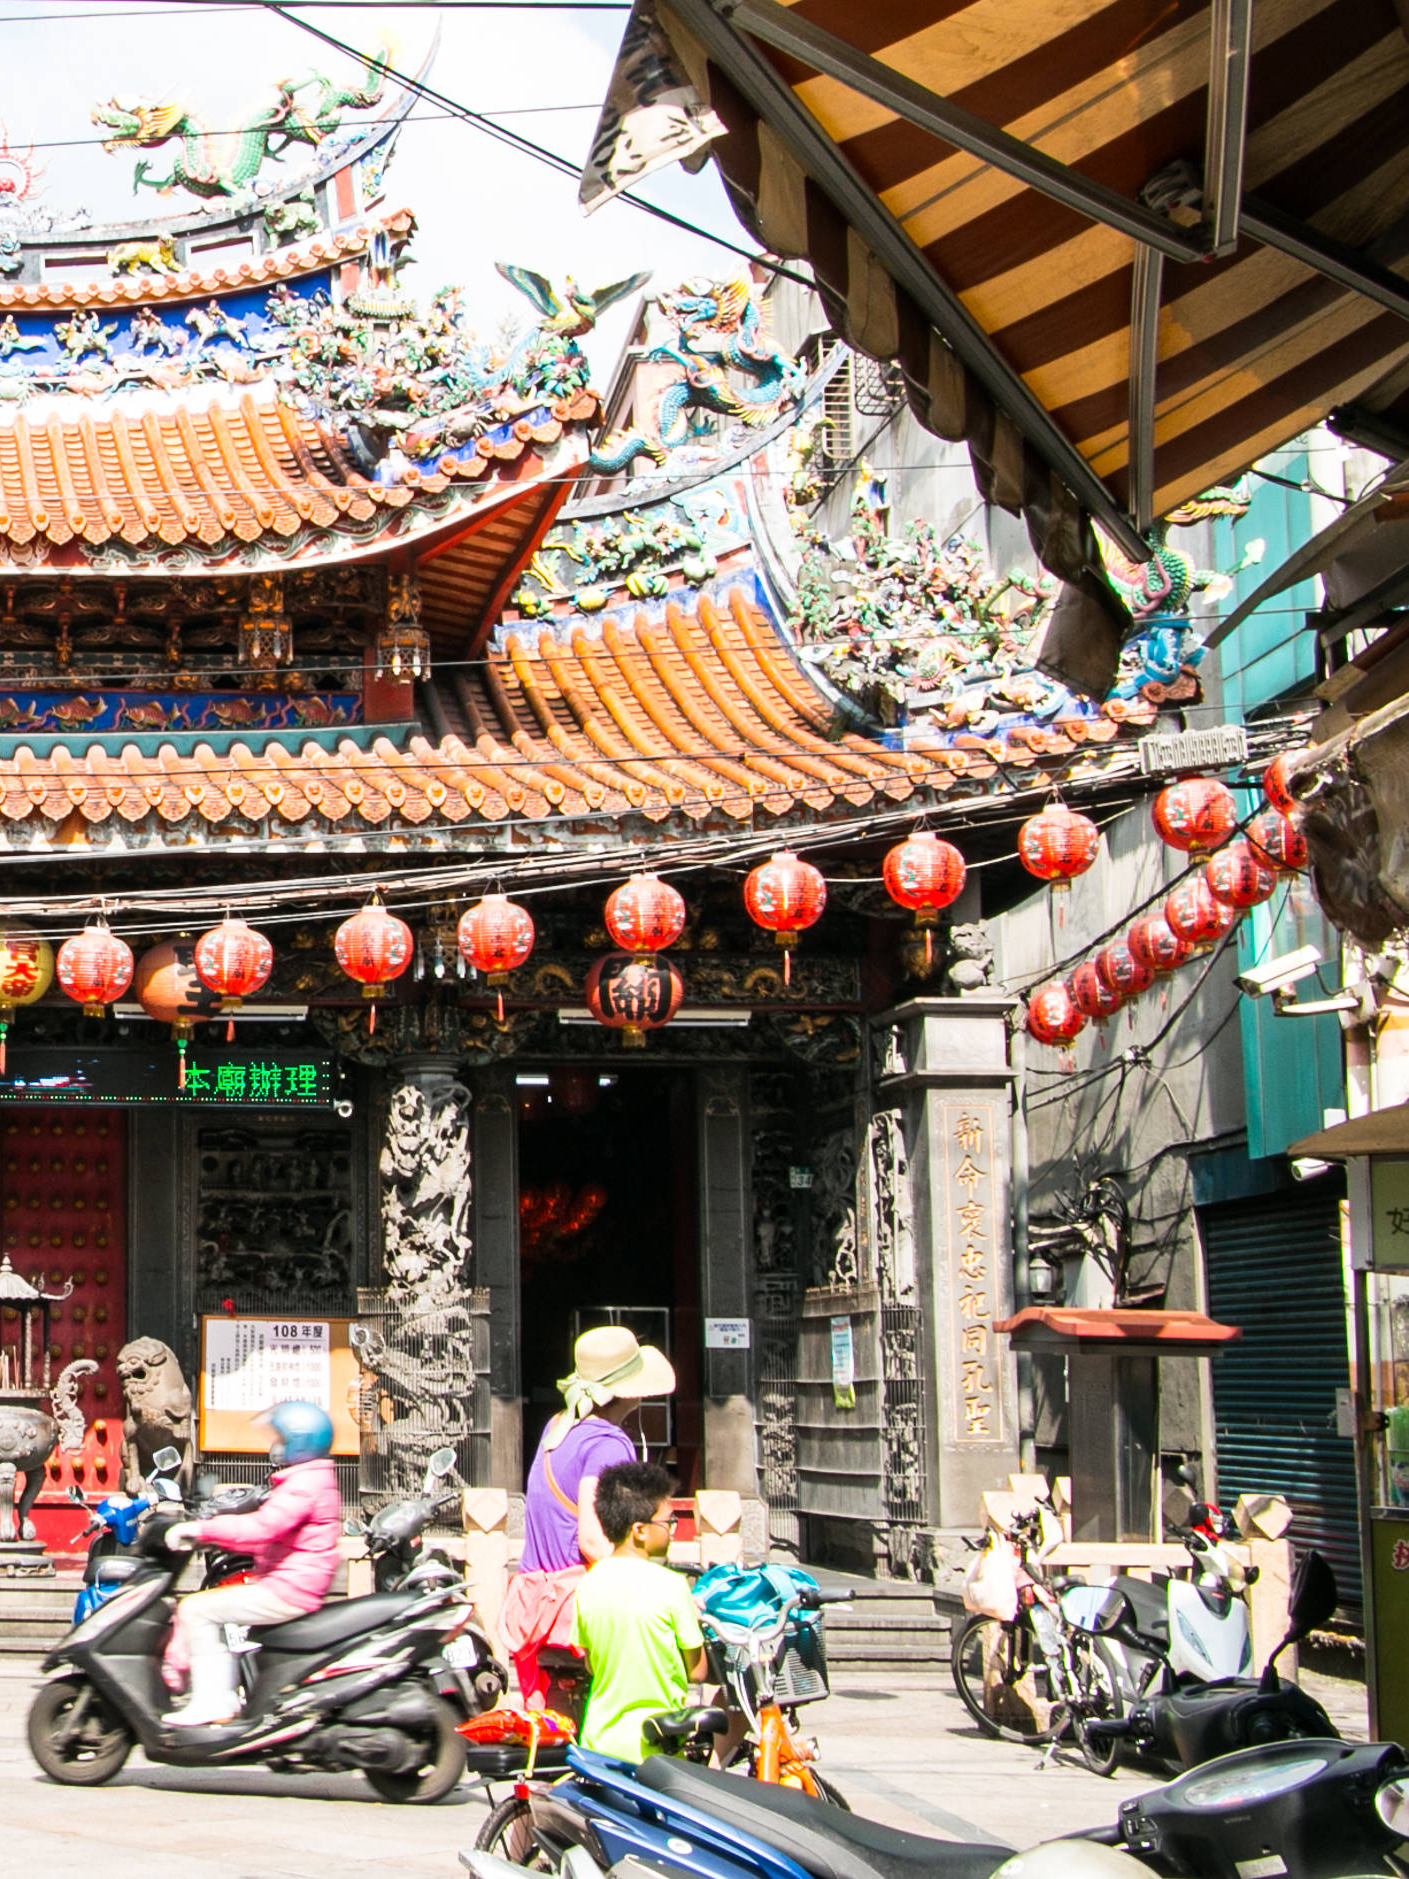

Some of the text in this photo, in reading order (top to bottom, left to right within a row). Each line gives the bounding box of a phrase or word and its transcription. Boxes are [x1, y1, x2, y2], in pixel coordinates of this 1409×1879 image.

[185, 1061, 317, 1097] 本廟辦理
[273, 1325, 298, 1338] 108
